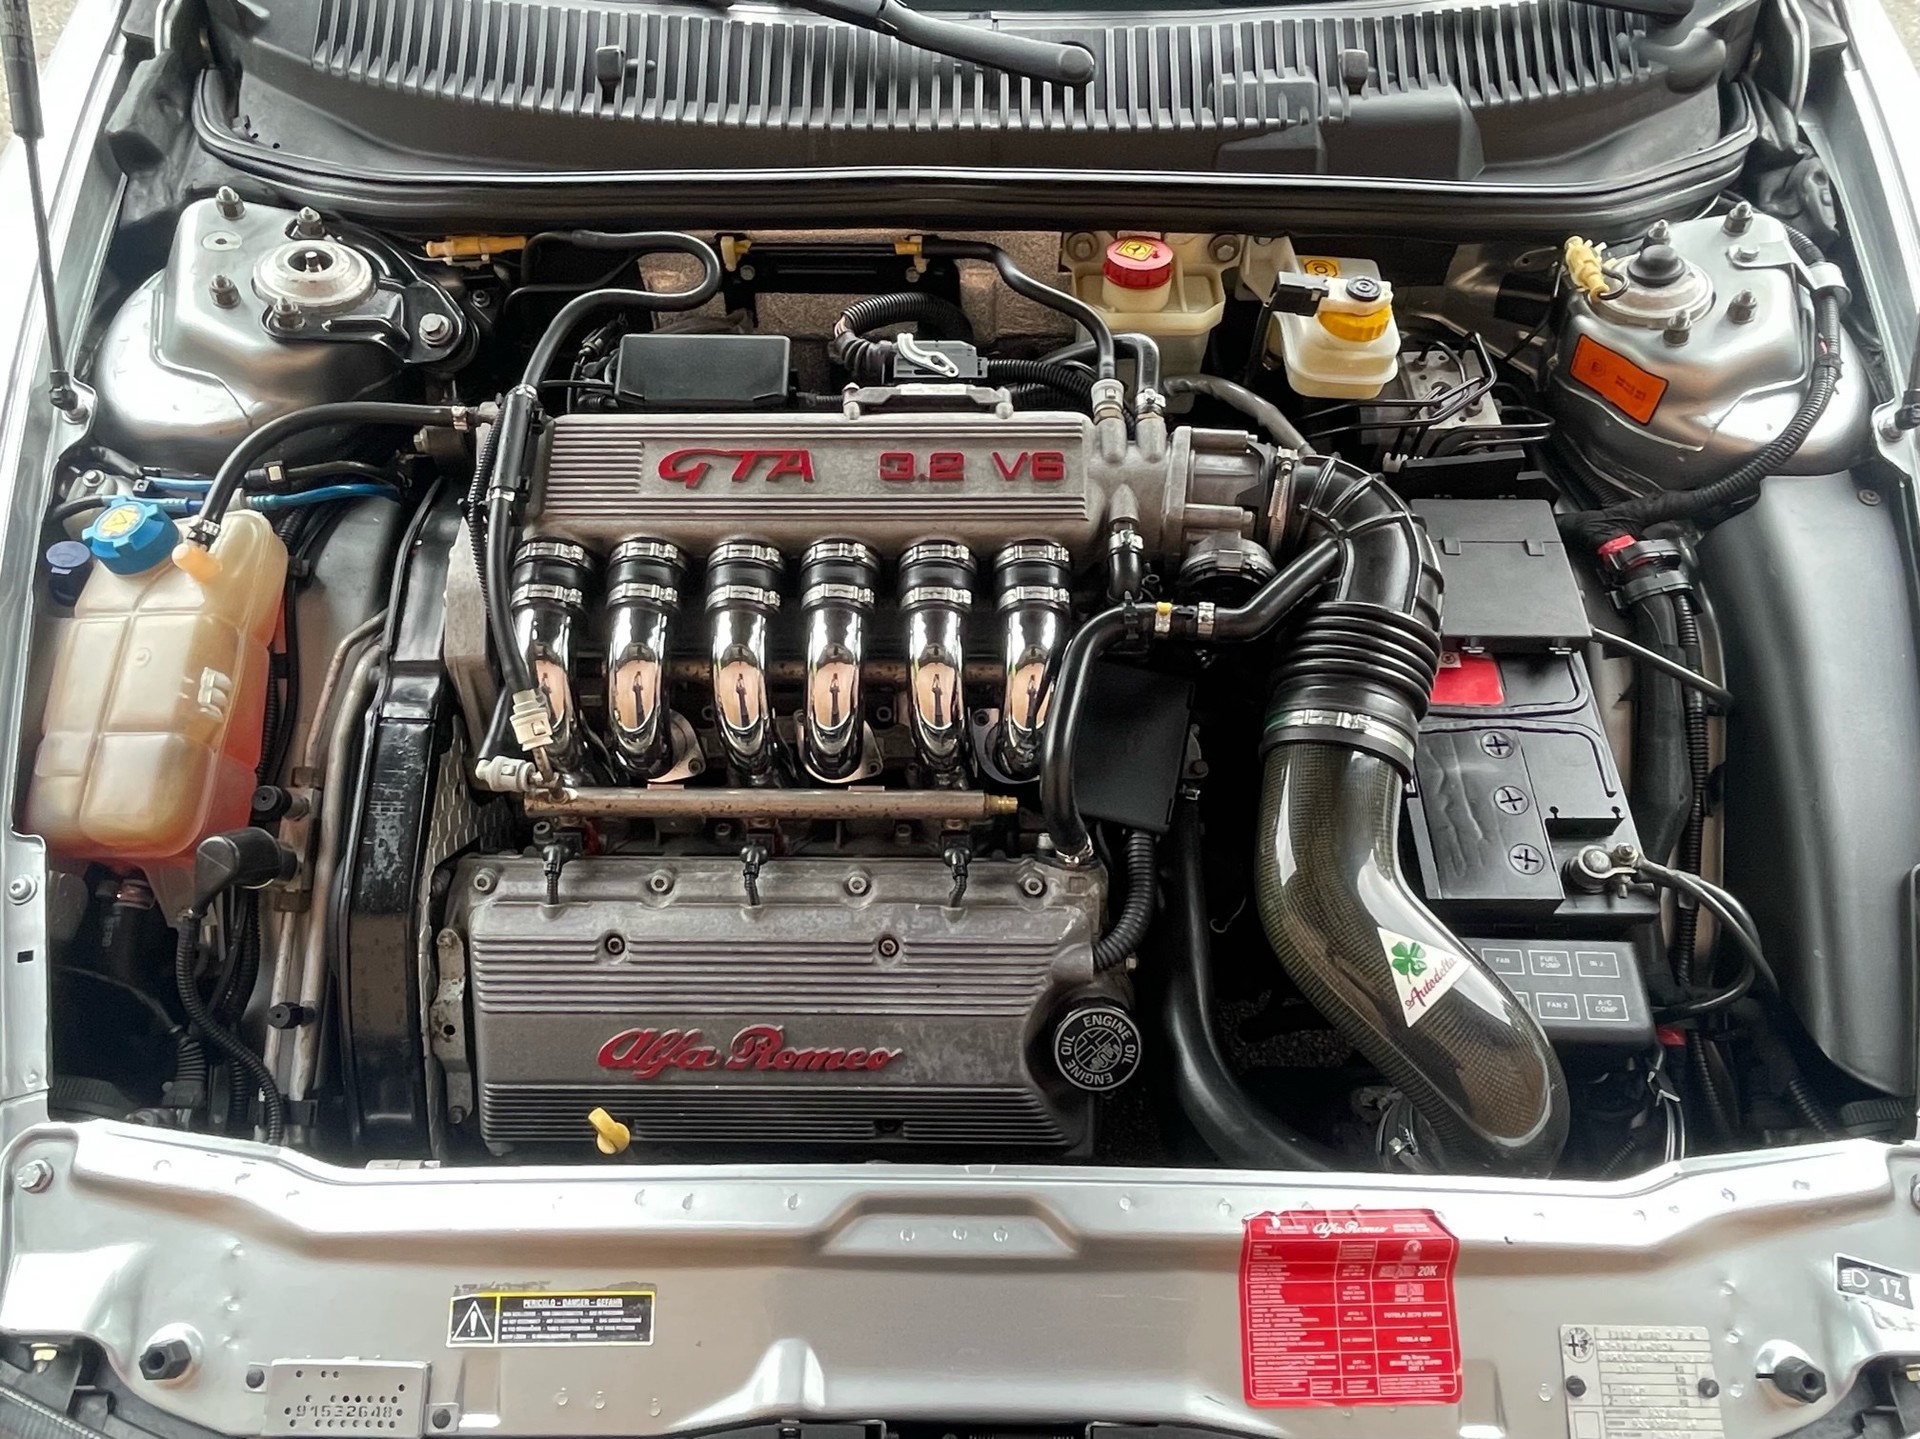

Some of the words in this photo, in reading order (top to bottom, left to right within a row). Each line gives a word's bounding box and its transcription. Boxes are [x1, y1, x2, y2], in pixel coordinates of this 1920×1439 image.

[657, 447, 815, 488] GTA
[878, 451, 964, 483] 3.2
[992, 451, 1064, 482] V6
[1495, 956, 1511, 964] FAN
[1404, 957, 1457, 1010] Autodelta
[1546, 1001, 1562, 1009] FAN
[1563, 1001, 1568, 1009] 2
[596, 1028, 721, 1079] Alfa
[726, 1023, 903, 1071] Romeo
[1060, 1035, 1076, 1056] OIL
[1082, 1014, 1132, 1041] ENGINE
[1121, 1044, 1137, 1064] OIL
[1064, 1059, 1114, 1085] ENGINE
[1417, 1265, 1438, 1276] 20K
